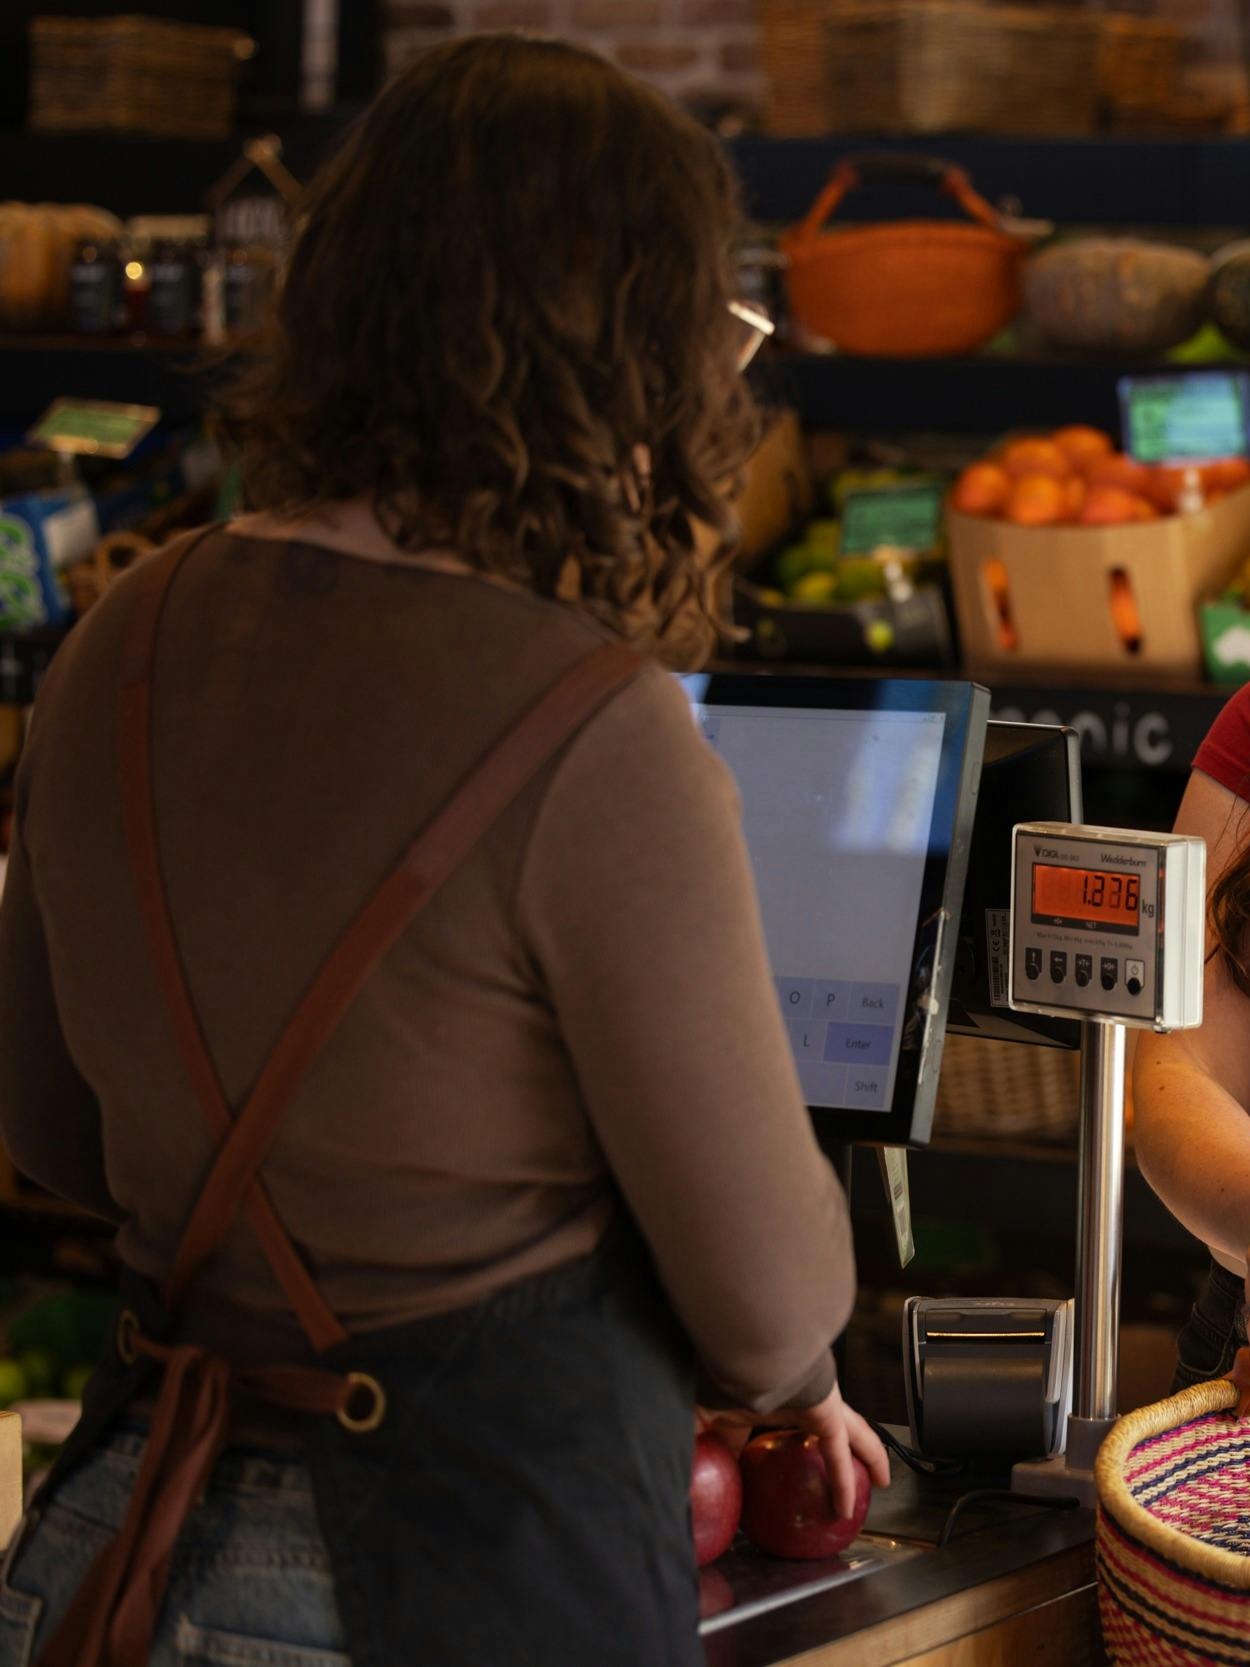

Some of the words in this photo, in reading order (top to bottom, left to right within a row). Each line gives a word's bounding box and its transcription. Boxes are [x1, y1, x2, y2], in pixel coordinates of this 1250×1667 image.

[1101, 852, 1147, 868] Wedderburn
[1142, 899, 1155, 918] kg
[789, 991, 801, 1005] O
[826, 993, 836, 1007] P
[862, 998, 885, 1009] Back
[803, 1033, 810, 1048] L
[845, 1037, 871, 1050] Enter
[855, 1080, 878, 1094] Shift
